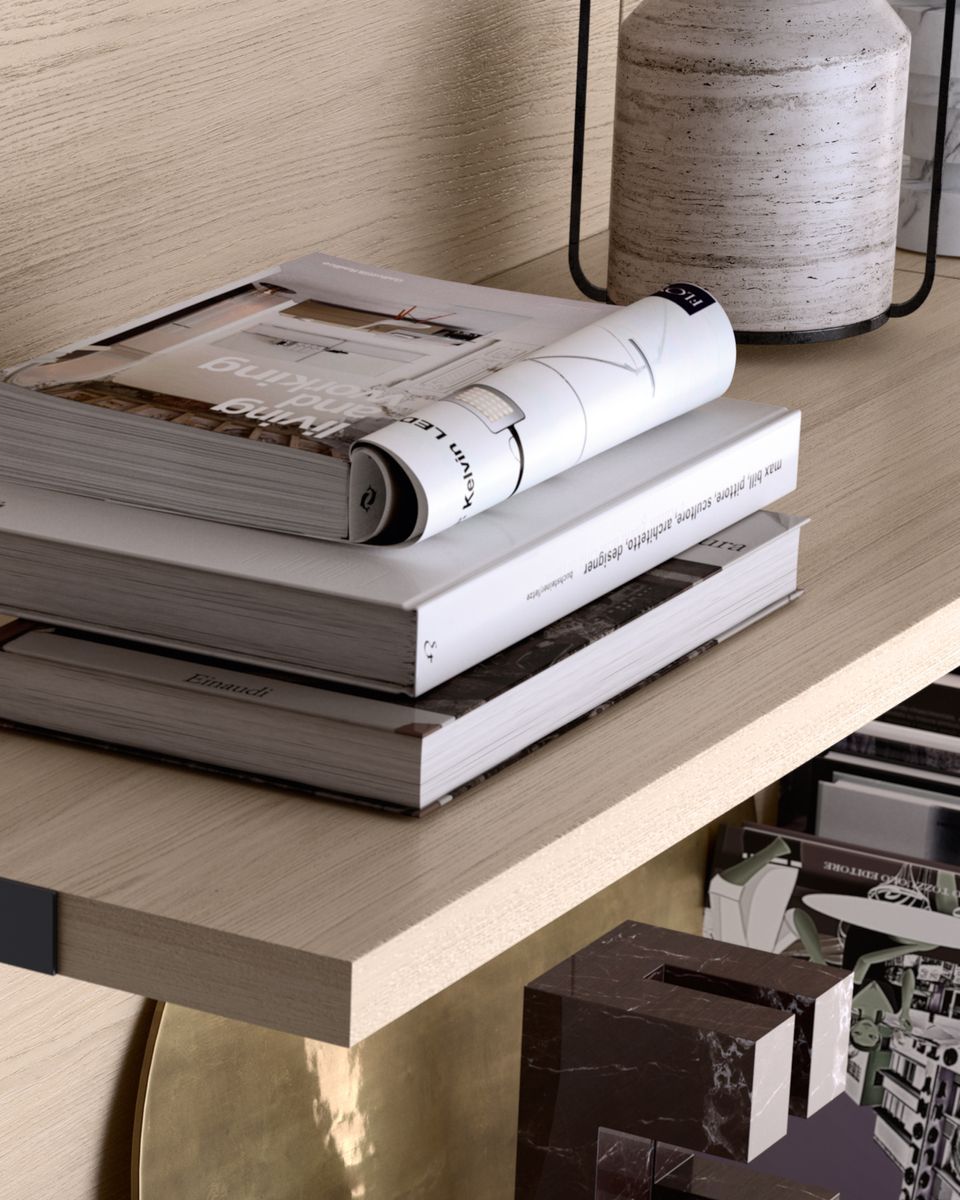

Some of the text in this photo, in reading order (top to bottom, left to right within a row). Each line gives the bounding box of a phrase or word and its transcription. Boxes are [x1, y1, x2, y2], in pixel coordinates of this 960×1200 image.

[662, 287, 703, 307] FLO
[198, 357, 405, 403] working
[275, 394, 382, 418] and
[210, 398, 350, 439] living
[400, 417, 475, 510] Kelvin LED
[765, 459, 782, 477] max
[748, 467, 762, 490] bill,
[714, 481, 745, 503] pittore,
[675, 498, 712, 525] scultore,
[625, 521, 673, 552] architetto,
[584, 545, 623, 576] designer
[185, 674, 274, 697] Einaudi
[824, 861, 880, 880] EDITORE
